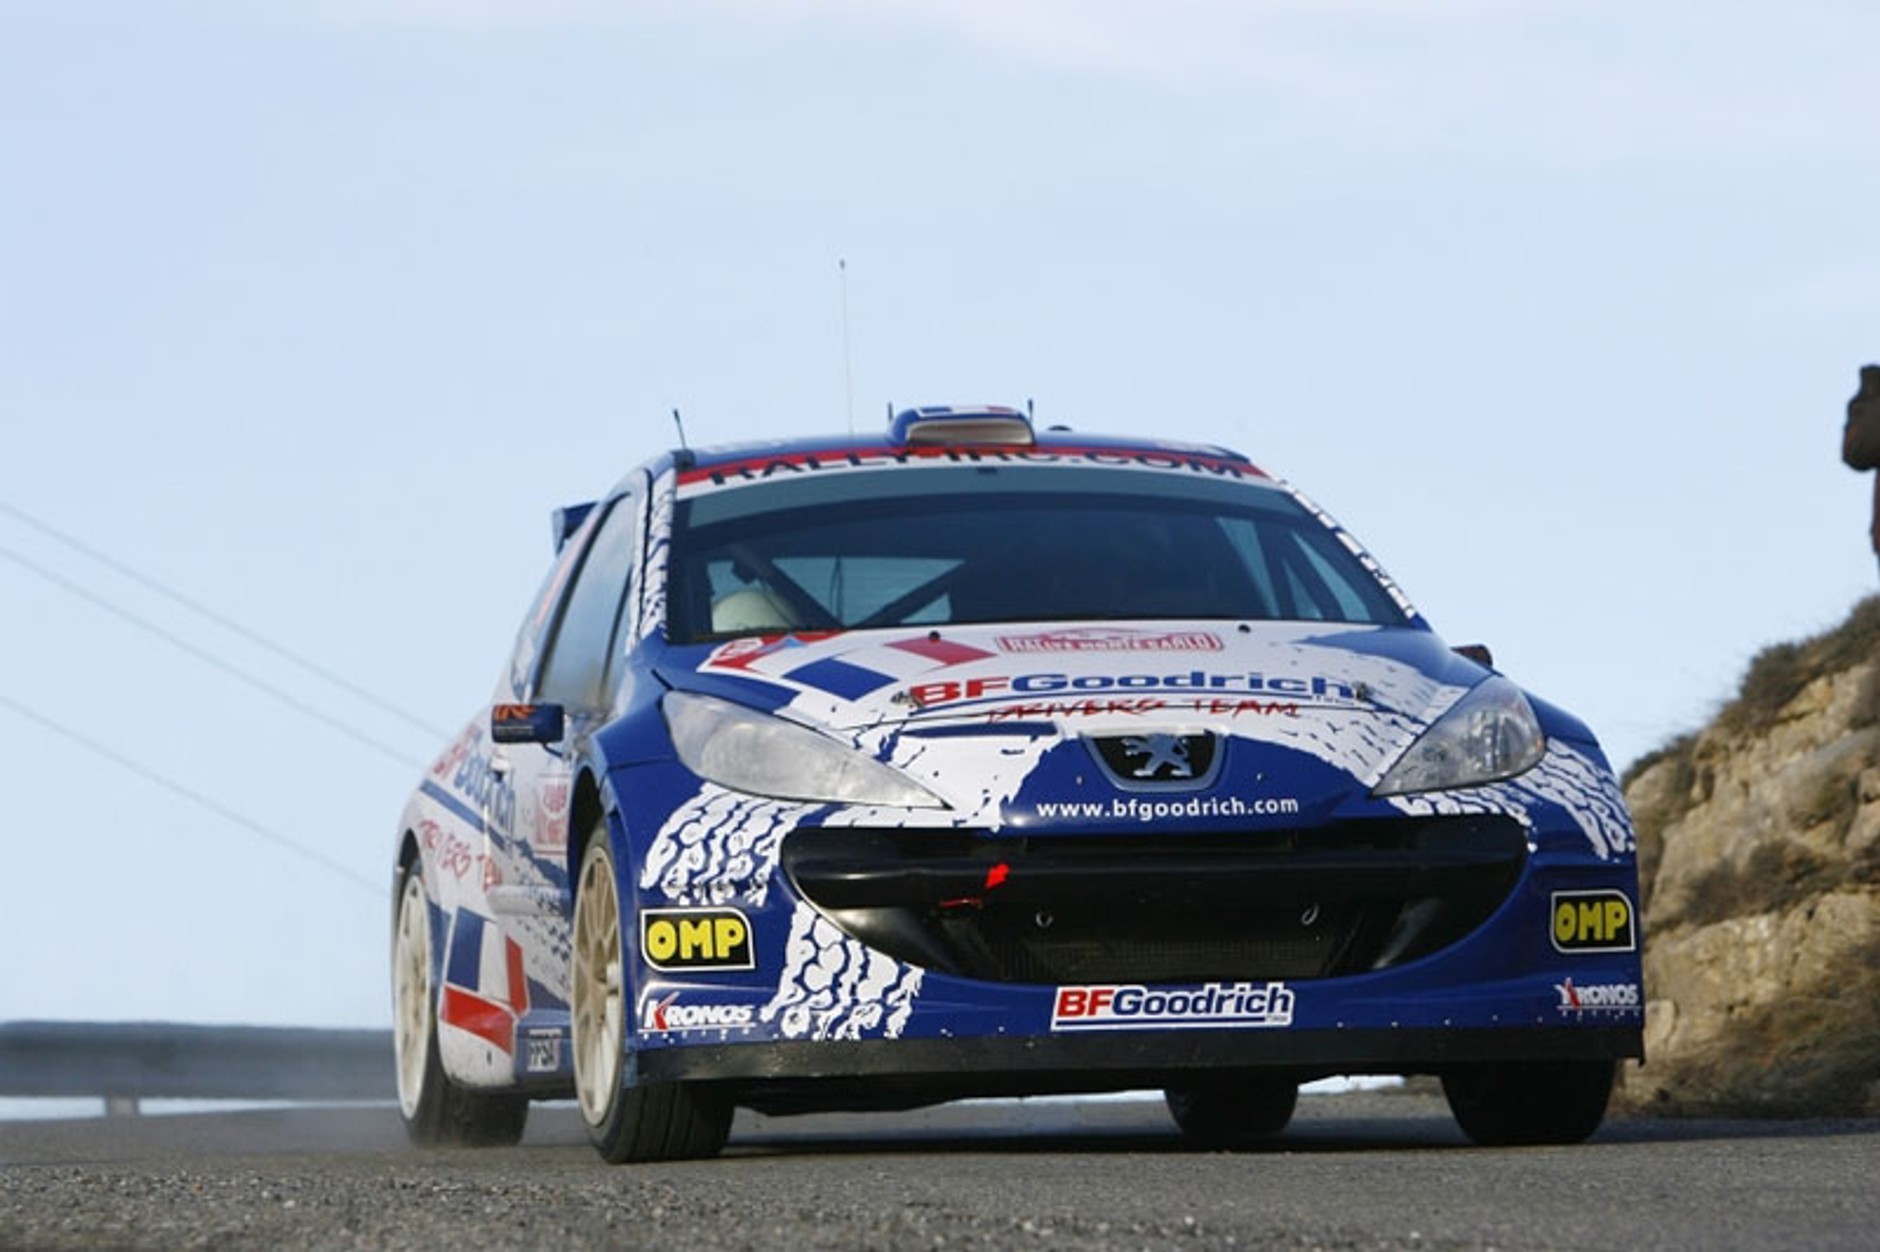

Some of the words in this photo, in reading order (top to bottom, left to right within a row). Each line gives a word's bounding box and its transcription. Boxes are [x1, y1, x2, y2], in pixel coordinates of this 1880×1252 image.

[907, 671, 1354, 704] BFGoodrich
[1195, 699, 1299, 719] TEAM
[1036, 797, 1299, 821] www.bfgoodrich.com
[1555, 901, 1628, 942] OMP
[648, 917, 746, 961] OMP
[1056, 983, 1291, 1018] BFGoodrich
[1553, 976, 1640, 1009] KRONOS
[644, 990, 755, 1031] KRONOS
